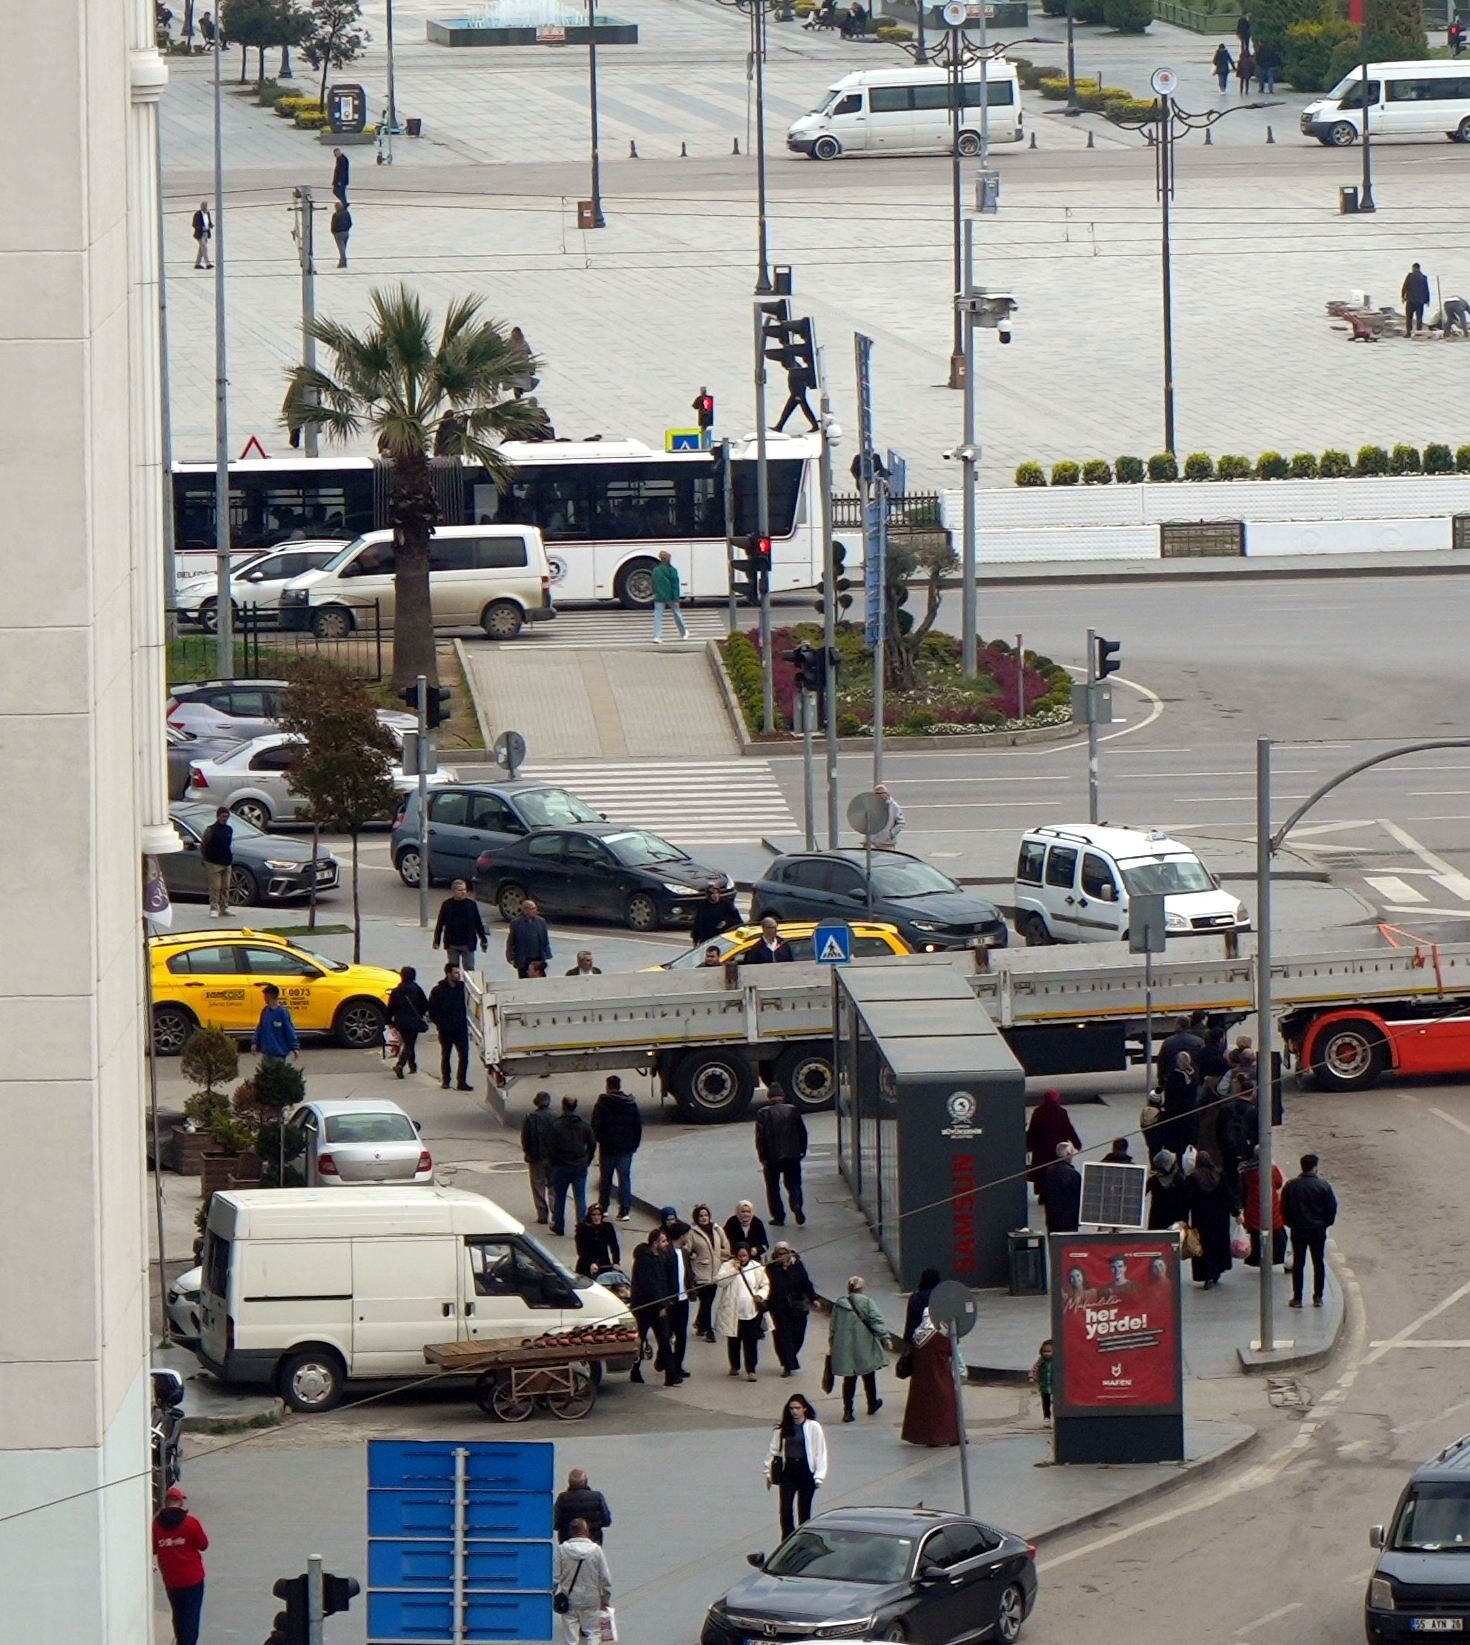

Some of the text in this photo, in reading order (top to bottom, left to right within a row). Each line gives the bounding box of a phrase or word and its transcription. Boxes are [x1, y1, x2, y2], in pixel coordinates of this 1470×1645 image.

[952, 1154, 976, 1274] SAMSUN
[1086, 1308, 1118, 1323] her
[1086, 1314, 1147, 1340] yerde!
